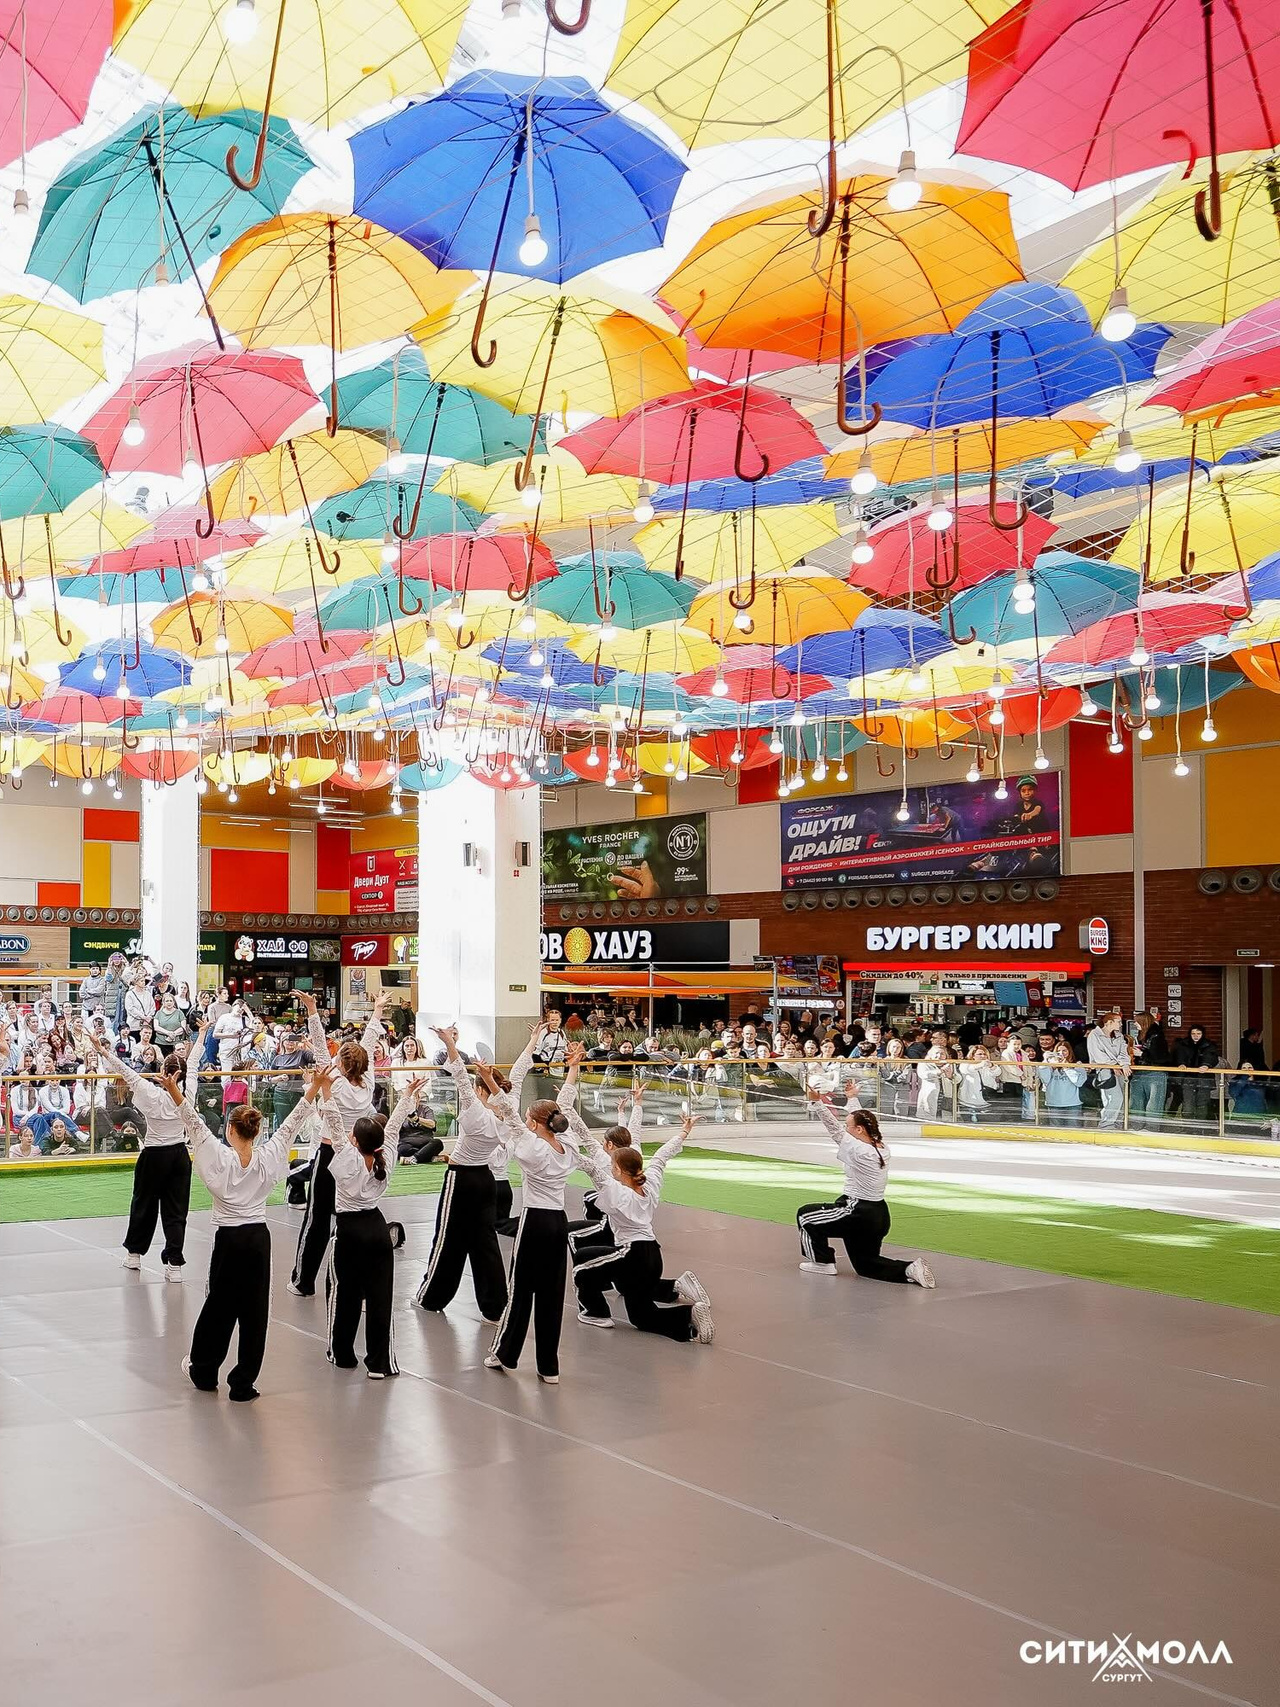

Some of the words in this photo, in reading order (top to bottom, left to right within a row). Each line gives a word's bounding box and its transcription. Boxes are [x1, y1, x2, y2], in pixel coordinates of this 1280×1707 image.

[787, 814, 857, 838] ОЩУТИ
[582, 835, 603, 845] YVES
[604, 831, 640, 842] ROCHER
[788, 835, 862, 862] ДРАЙВ!
[801, 862, 832, 872] РОЖДЕНИЯ
[840, 855, 892, 866] ИНТЕРАКТИВНЫЙ
[892, 849, 934, 860] АЭРОХОККЕЙ
[973, 836, 1036, 850] СТРАЙКБОЛЬНЫЙ
[1038, 835, 1052, 843] ТИР
[354, 876, 373, 888] Двери
[375, 875, 389, 887] Дуэт
[866, 925, 971, 950] БУРГЕР
[977, 923, 1061, 950] КИНГ
[1090, 938, 1107, 946] KING
[84, 941, 120, 949] СЭНДВИЧИ
[257, 938, 285, 952] ХАЙ
[289, 940, 308, 953] ФО
[540, 933, 563, 960] ОВ
[593, 930, 652, 960] ХАУЗ
[860, 971, 893, 980] Скидки
[894, 972, 904, 980] до
[905, 971, 924, 979] 40%
[977, 973, 1027, 981] приложении
